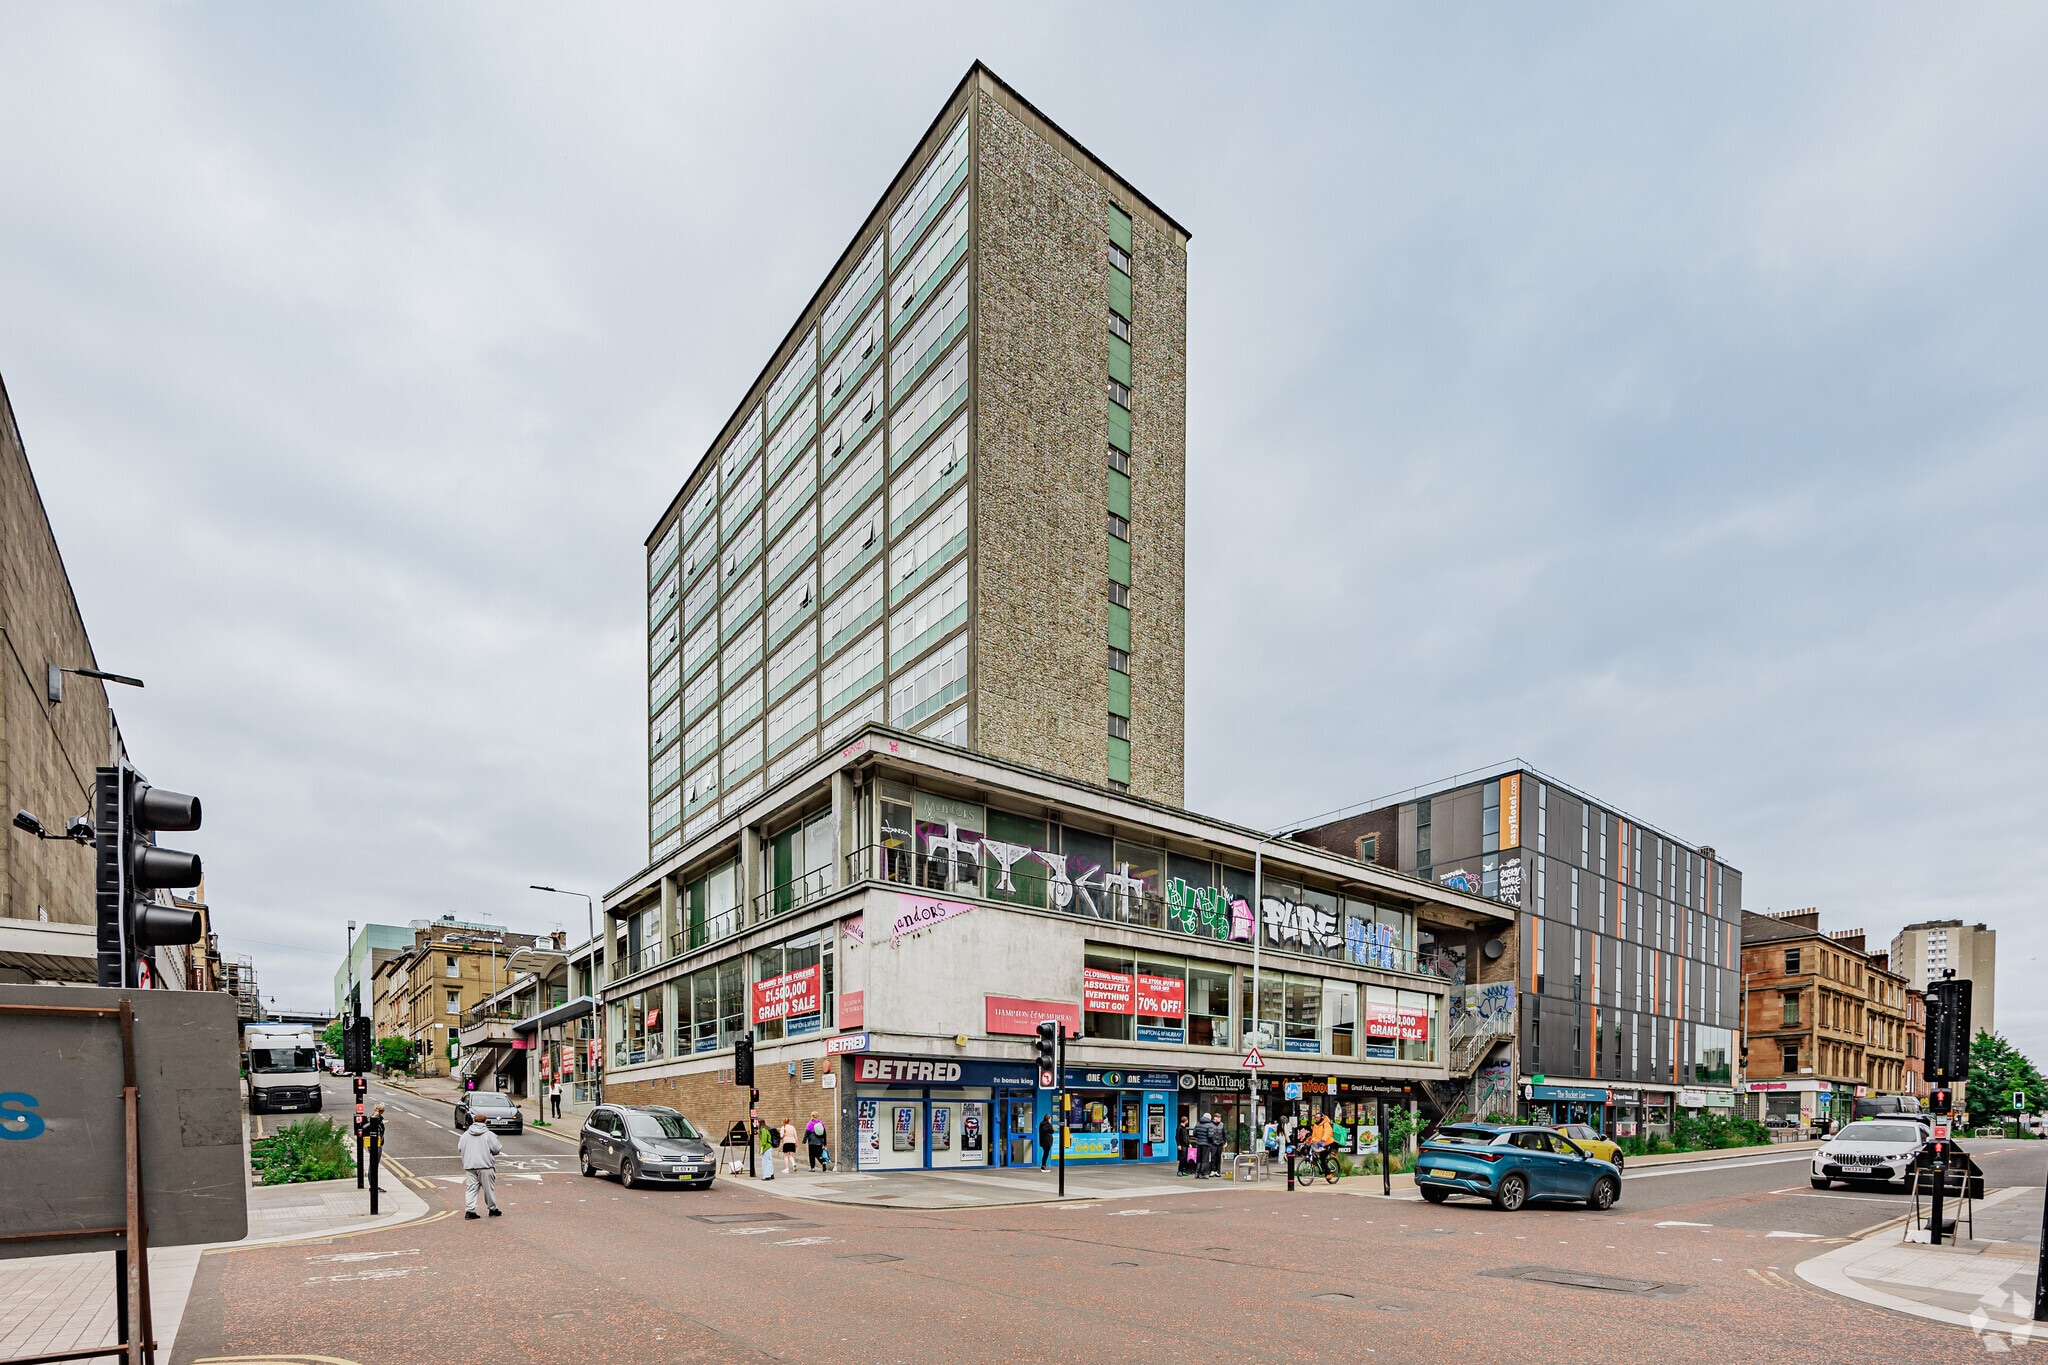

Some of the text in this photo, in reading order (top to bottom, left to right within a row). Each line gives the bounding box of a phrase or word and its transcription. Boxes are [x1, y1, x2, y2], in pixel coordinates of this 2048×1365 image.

[1508, 777, 1518, 845] easyHotel.com
[758, 980, 777, 990] CLOSING
[793, 968, 815, 979] FOREVER
[1084, 970, 1111, 980] CLOSING
[1084, 981, 1130, 992] ABSOLUTELY
[1085, 991, 1130, 1002] EVERYTHING
[758, 995, 816, 1020] GRAND SALE
[1089, 1001, 1125, 1011] MUST GO!
[1138, 997, 1182, 1014] 70% OFF!
[995, 1008, 1029, 1018] HAMPTON
[1030, 1010, 1038, 1019] &
[1370, 1024, 1422, 1039] GRAND SALE
[828, 1035, 866, 1053] BETFRED
[861, 1059, 962, 1082] BETFRED
[1001, 1076, 1020, 1084] bonus
[1021, 1077, 1034, 1086] king
[1086, 1073, 1100, 1082] ONE
[1127, 1075, 1141, 1084] ONE
[1197, 1074, 1245, 1091] HuaYiTang
[1374, 1085, 1390, 1093] Amazing
[859, 1101, 877, 1119] £5
[898, 1109, 912, 1122] £5
[934, 1109, 947, 1123] £5
[858, 1120, 875, 1129] FREE
[896, 1123, 910, 1131] FREE
[932, 1123, 946, 1131] FREE
